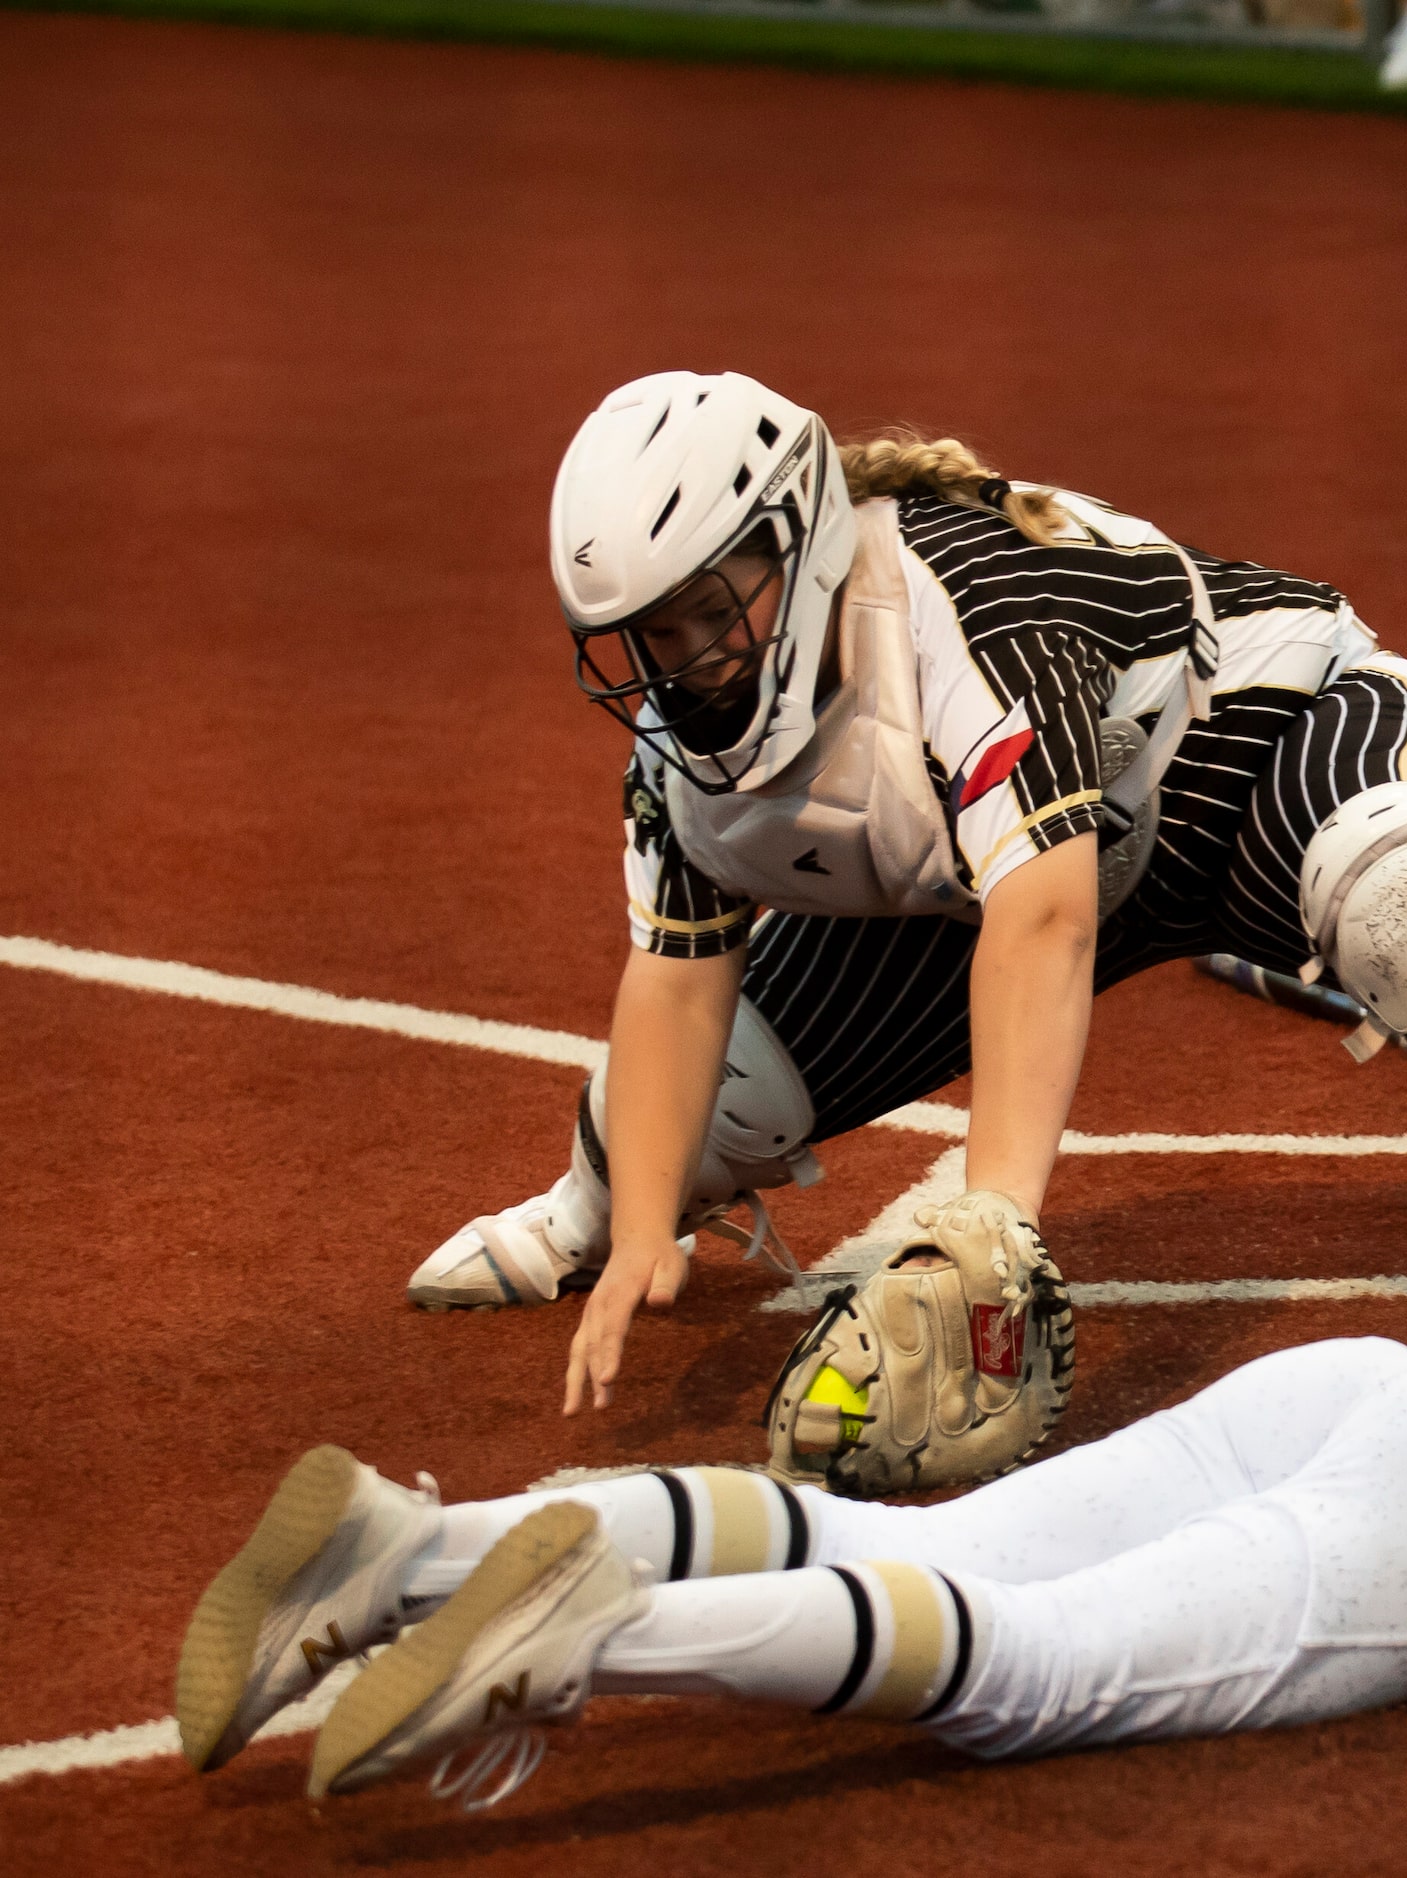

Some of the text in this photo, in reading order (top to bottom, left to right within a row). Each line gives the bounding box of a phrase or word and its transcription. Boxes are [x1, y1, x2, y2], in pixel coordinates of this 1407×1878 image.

[761, 455, 799, 502] EASTON
[301, 1619, 350, 1676] N
[484, 1668, 531, 1726] N
